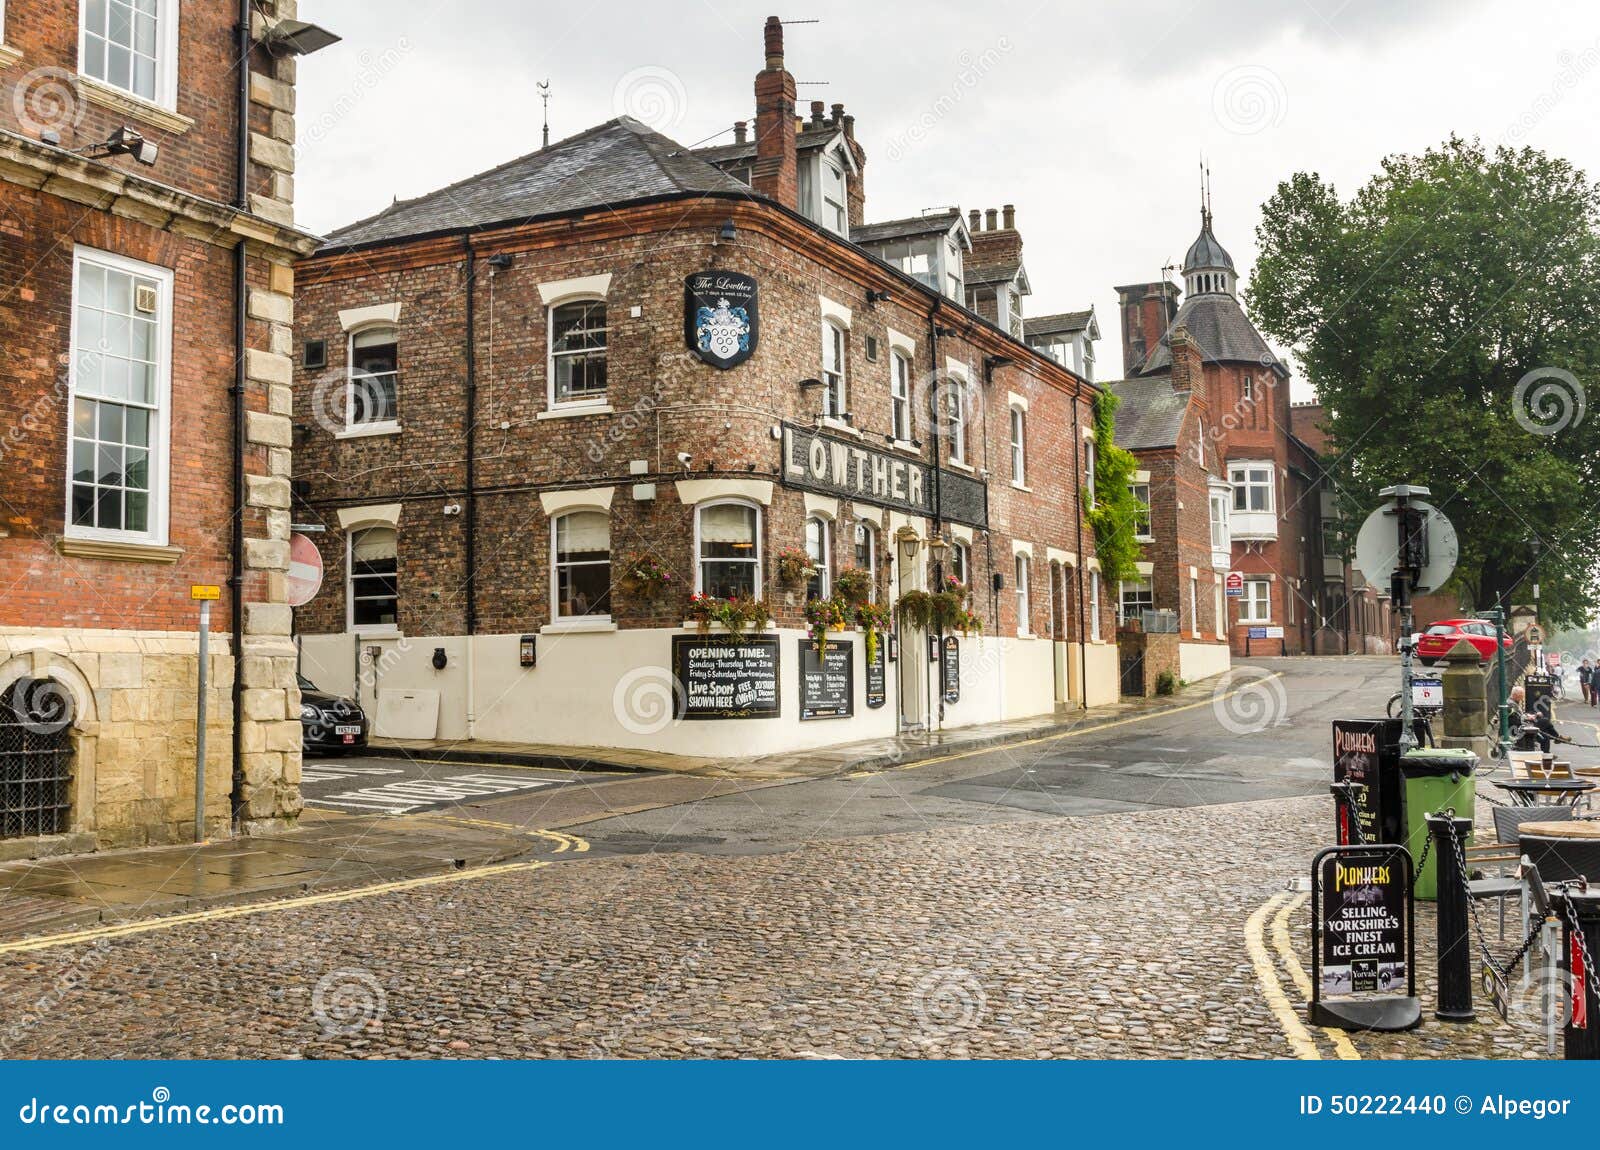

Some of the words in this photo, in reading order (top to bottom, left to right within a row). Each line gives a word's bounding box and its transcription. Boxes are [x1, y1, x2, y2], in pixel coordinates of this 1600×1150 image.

[693, 277, 712, 289] The
[715, 276, 752, 291] Lowther
[784, 427, 924, 506] LOWTHER
[688, 648, 736, 659] OPENING
[688, 659, 715, 670] Sunday
[719, 659, 744, 669] Thursday
[689, 669, 707, 679] Friday
[712, 670, 737, 680] Saturday
[688, 681, 708, 695] Live
[709, 681, 734, 696] Sport
[737, 680, 751, 693] FREE
[688, 696, 715, 708] SHOWN
[715, 696, 733, 708] HERE
[1364, 833, 1376, 842] LATE
[1335, 860, 1391, 893] PLONKERS
[1341, 906, 1387, 919] SELLING
[1328, 915, 1399, 932] YORKSHIRE'S
[1346, 931, 1382, 943] FINEST
[1332, 945, 1352, 957] ICE
[1354, 942, 1396, 955] CREAM
[1352, 969, 1377, 978] Yorvale
